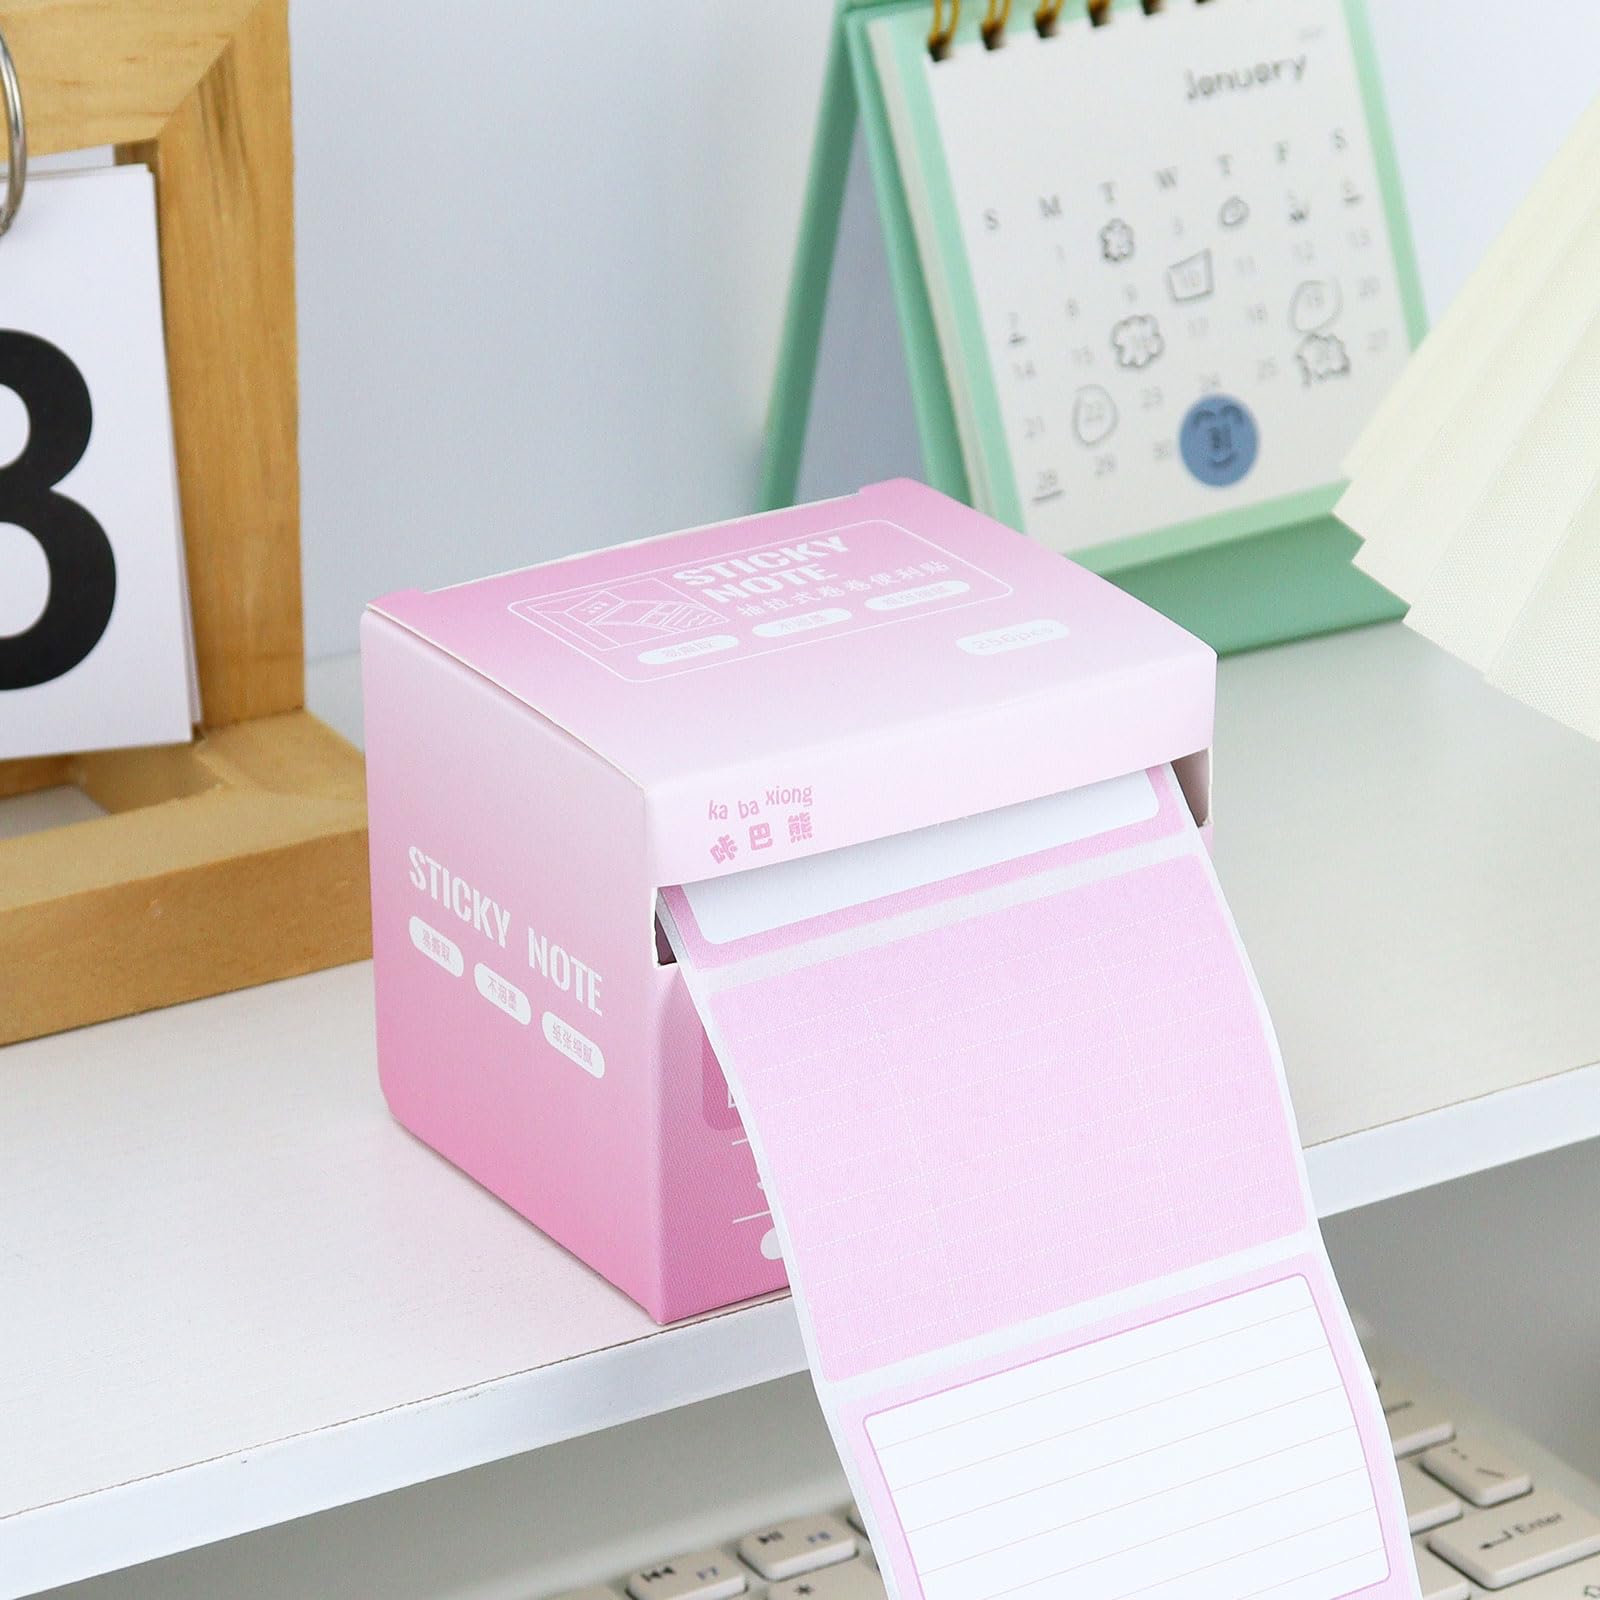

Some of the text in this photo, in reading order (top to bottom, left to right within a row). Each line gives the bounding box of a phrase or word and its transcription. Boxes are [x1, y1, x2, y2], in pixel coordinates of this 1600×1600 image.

[1184, 53, 1307, 101] January
[983, 127, 1347, 231] S M T W T F S
[672, 534, 850, 586] STICKY
[701, 562, 840, 604] NOTE
[708, 784, 813, 820] ka ba xiong
[407, 846, 603, 1017] STICKY NOTE
